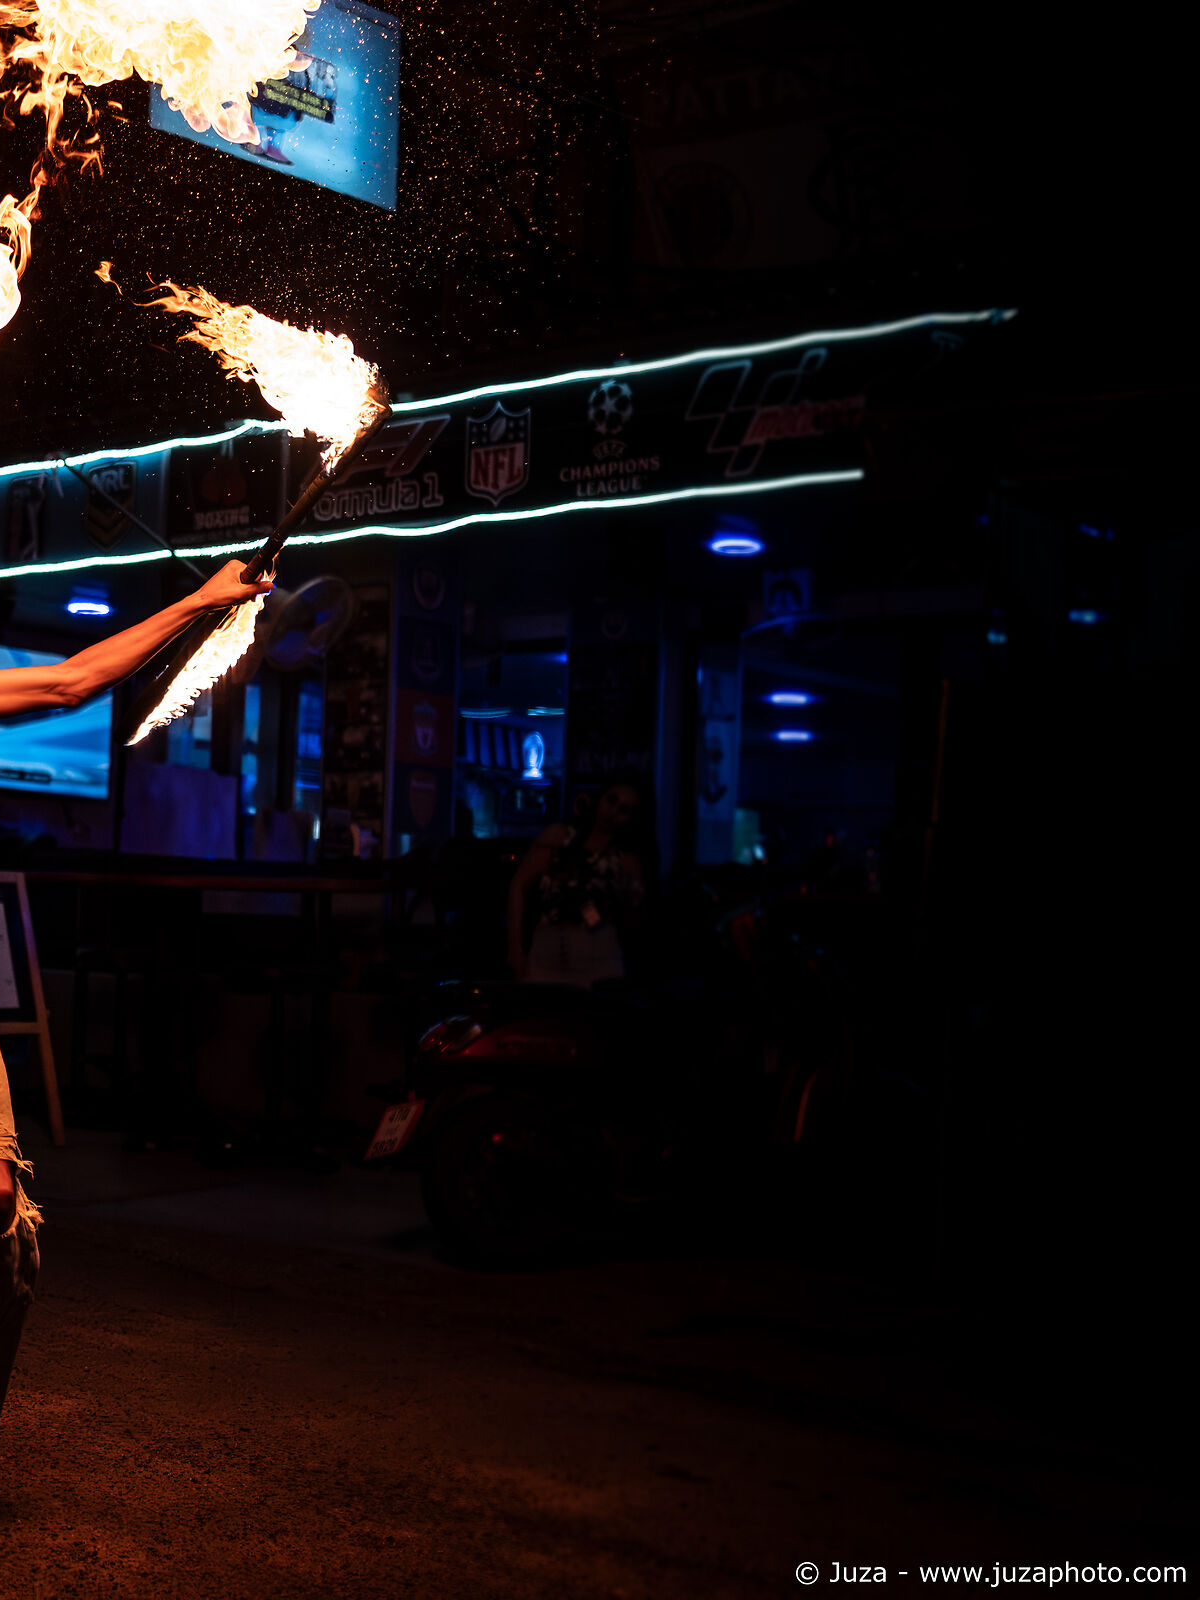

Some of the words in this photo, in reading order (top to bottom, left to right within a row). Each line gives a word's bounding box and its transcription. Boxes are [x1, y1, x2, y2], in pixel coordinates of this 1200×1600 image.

[471, 446, 523, 491] NFL
[558, 453, 663, 483] CHAMPIONS
[575, 474, 643, 498] LEAGUE
